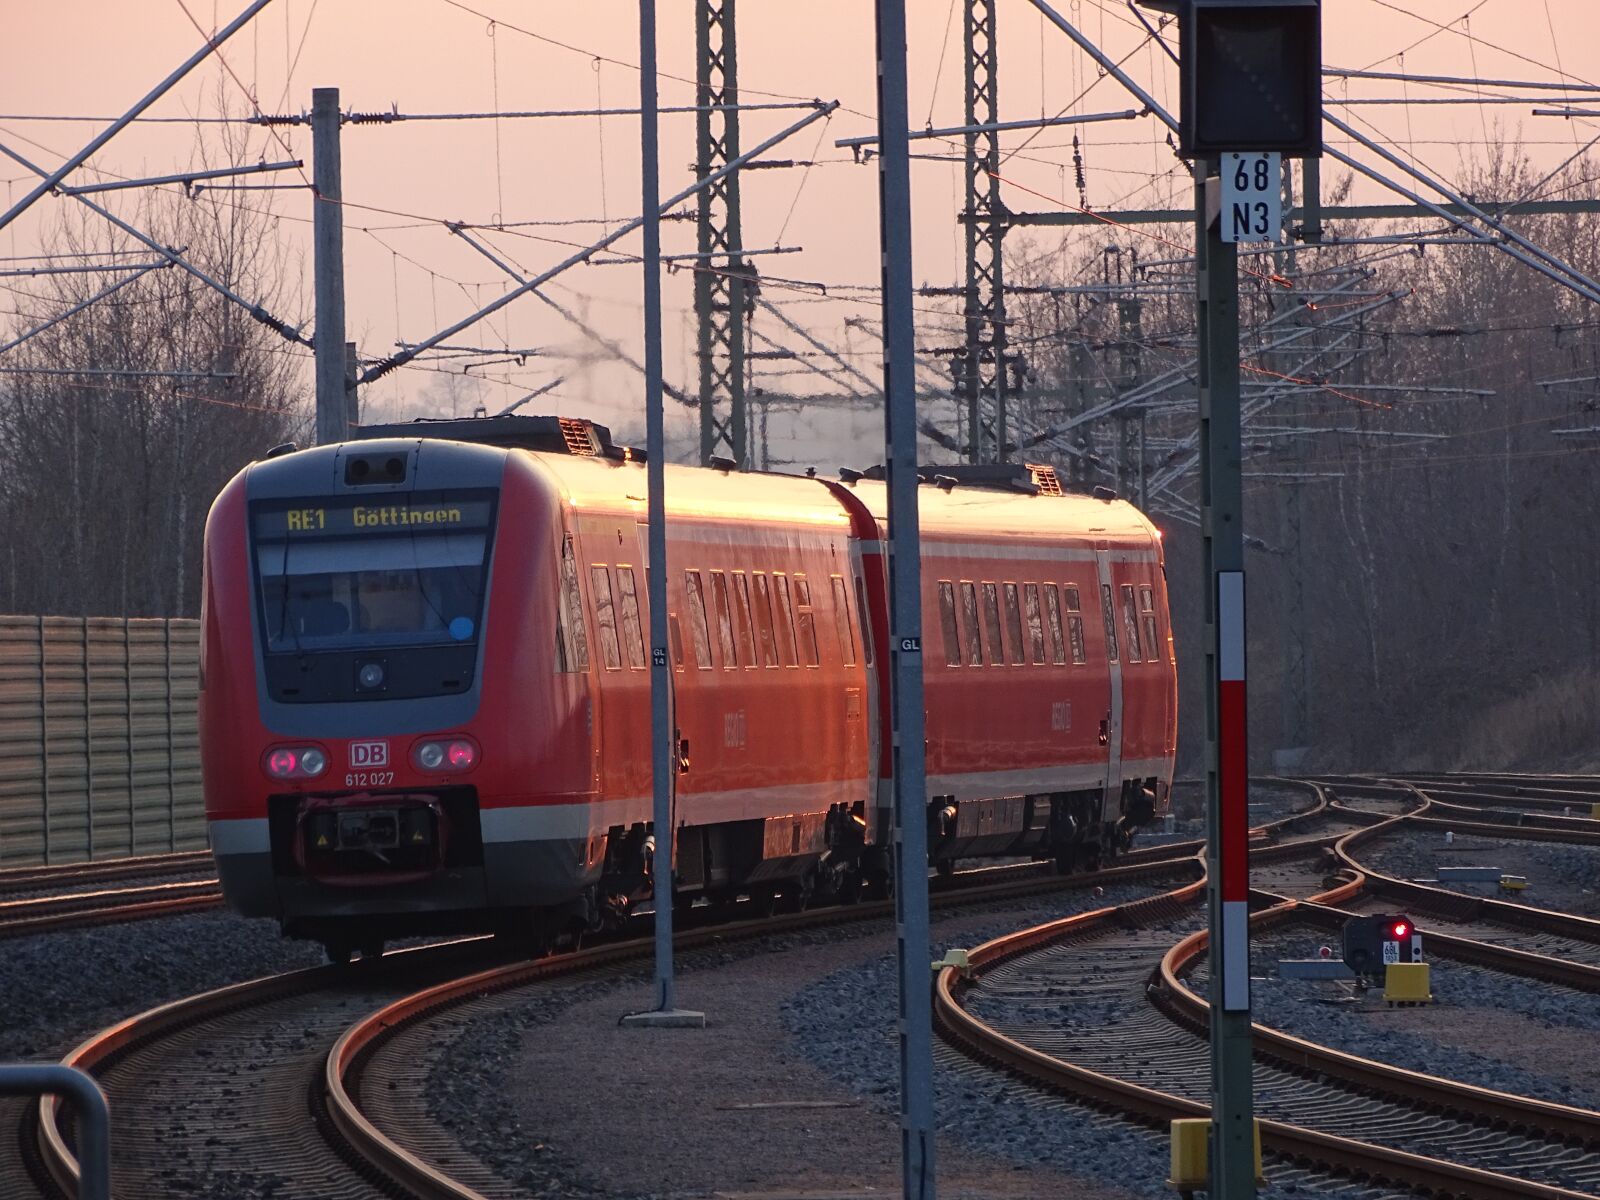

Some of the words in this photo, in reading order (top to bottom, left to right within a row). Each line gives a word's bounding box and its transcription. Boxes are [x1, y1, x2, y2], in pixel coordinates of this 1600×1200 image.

[1234, 159, 1269, 191] 68
[1233, 202, 1269, 235] N3
[287, 509, 326, 531] RE1
[353, 506, 462, 527] Göttingen
[653, 648, 665, 656] GL
[901, 639, 920, 650] GL
[654, 657, 665, 665] 14
[353, 743, 385, 765] DB
[345, 773, 368, 786] 612
[370, 771, 394, 785] 027
